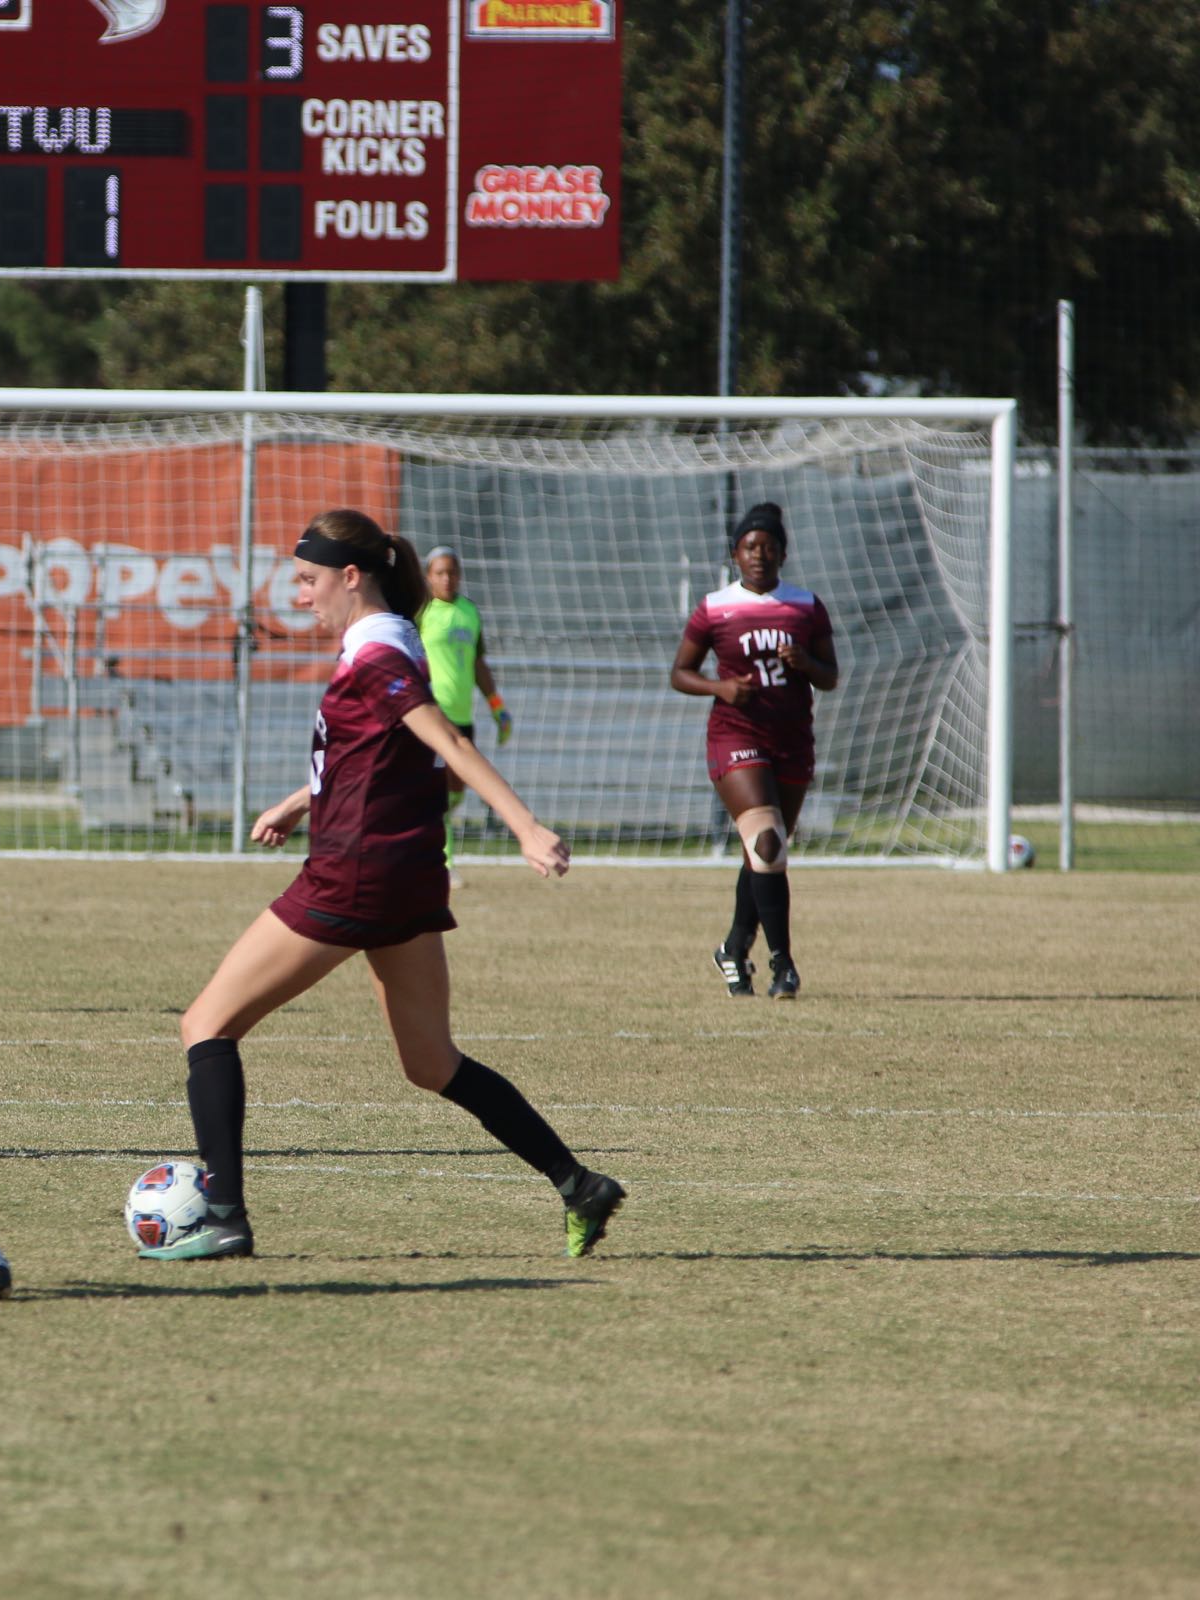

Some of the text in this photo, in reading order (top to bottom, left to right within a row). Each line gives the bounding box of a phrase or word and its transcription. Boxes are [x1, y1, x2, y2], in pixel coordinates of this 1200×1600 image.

[265, 6, 303, 79] 3
[316, 23, 432, 62] SAVES
[301, 98, 445, 138] CORNER
[322, 137, 426, 176] KICKS
[478, 167, 601, 195] GREASE
[104, 175, 119, 257] 1
[314, 200, 429, 239] FOULS
[467, 195, 609, 227] MONKEY
[753, 658, 788, 687] 12
